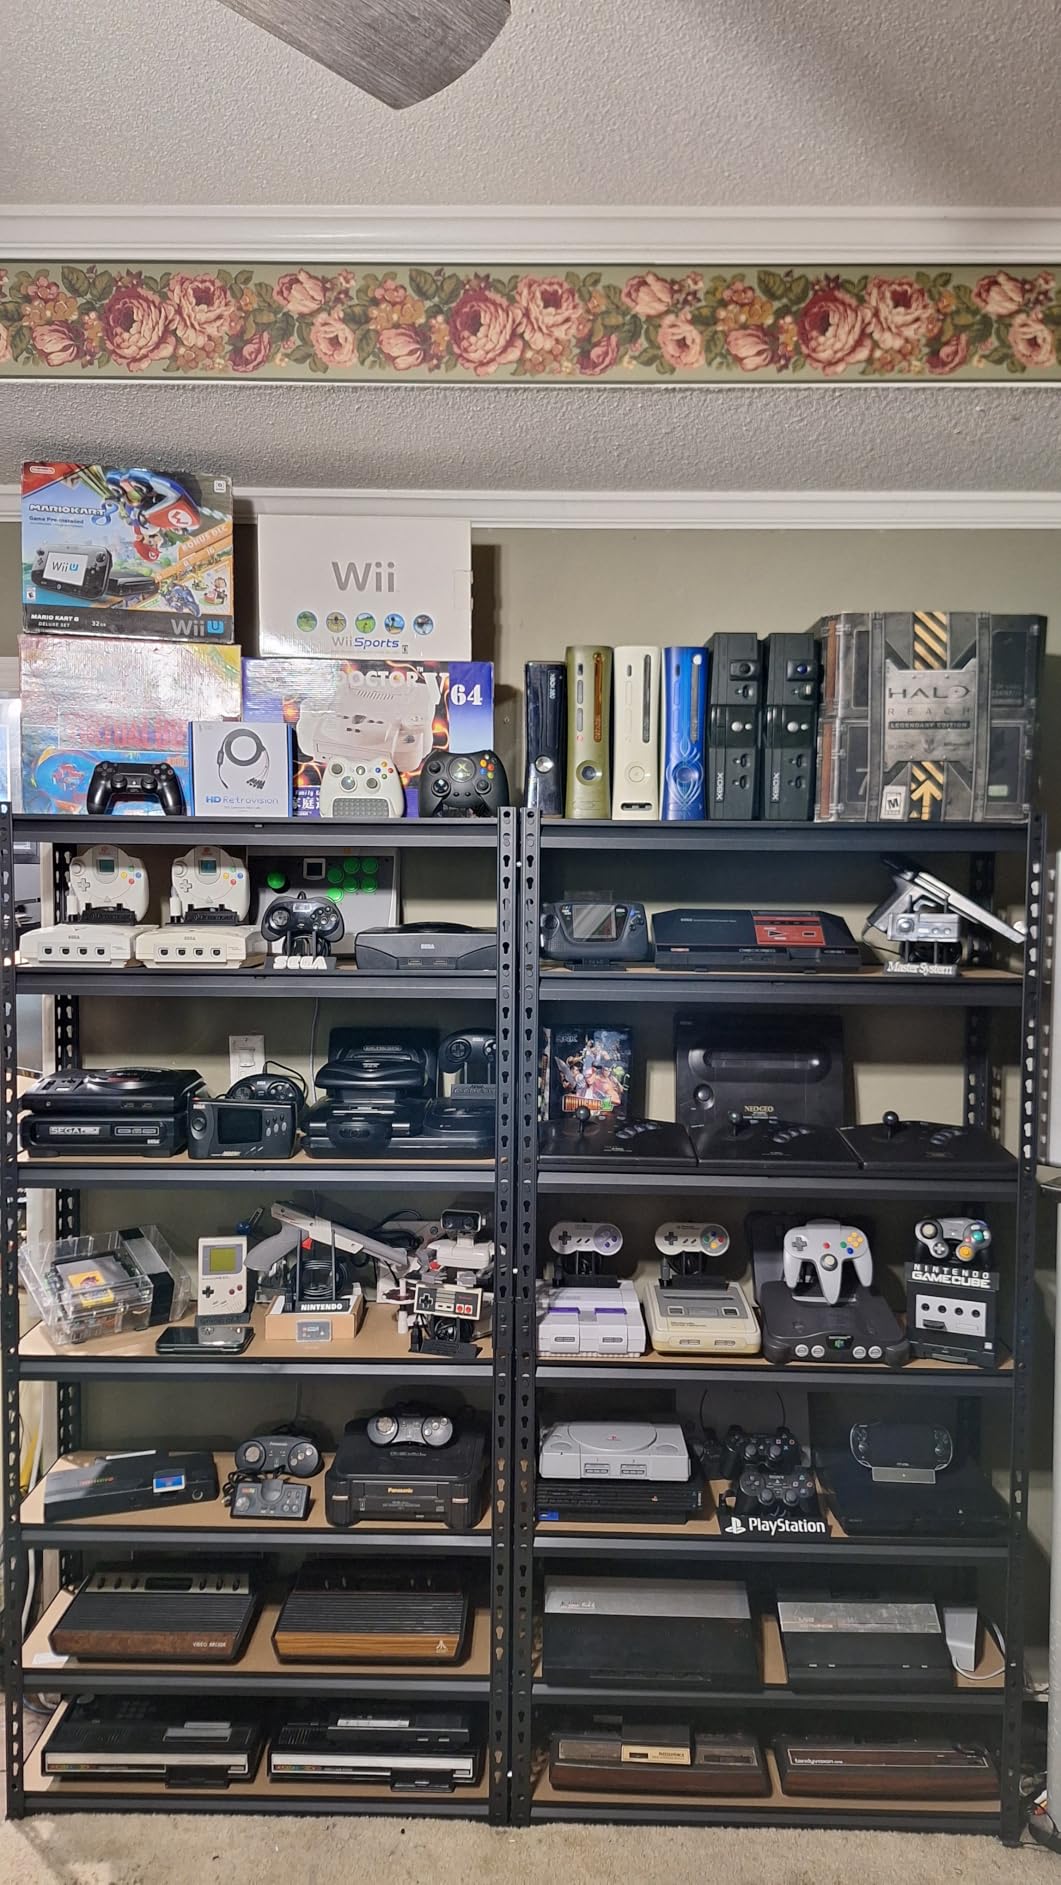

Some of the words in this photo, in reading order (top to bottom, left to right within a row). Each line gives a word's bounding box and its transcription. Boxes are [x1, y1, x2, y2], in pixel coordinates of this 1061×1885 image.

[52, 561, 68, 572] Wii
[331, 561, 395, 592] Wii
[171, 619, 204, 636] Wii
[207, 620, 224, 634] U
[331, 636, 353, 647] Wii
[354, 637, 400, 649] Sports
[336, 671, 419, 688] DOCTOR
[451, 684, 483, 706] 64
[888, 685, 971, 699] HALO
[888, 707, 970, 716] REACH
[772, 772, 780, 801] XBOX
[205, 795, 221, 803] HD
[222, 795, 279, 805] Retrovision
[887, 798, 899, 809] M
[273, 955, 327, 969] SEGA
[49, 1126, 80, 1135] SEGA
[913, 1263, 990, 1280] NINTENDO
[911, 1270, 991, 1289] GAMECUBE
[301, 1303, 343, 1311] NINTENDO
[748, 1517, 826, 1536] PlayStation
